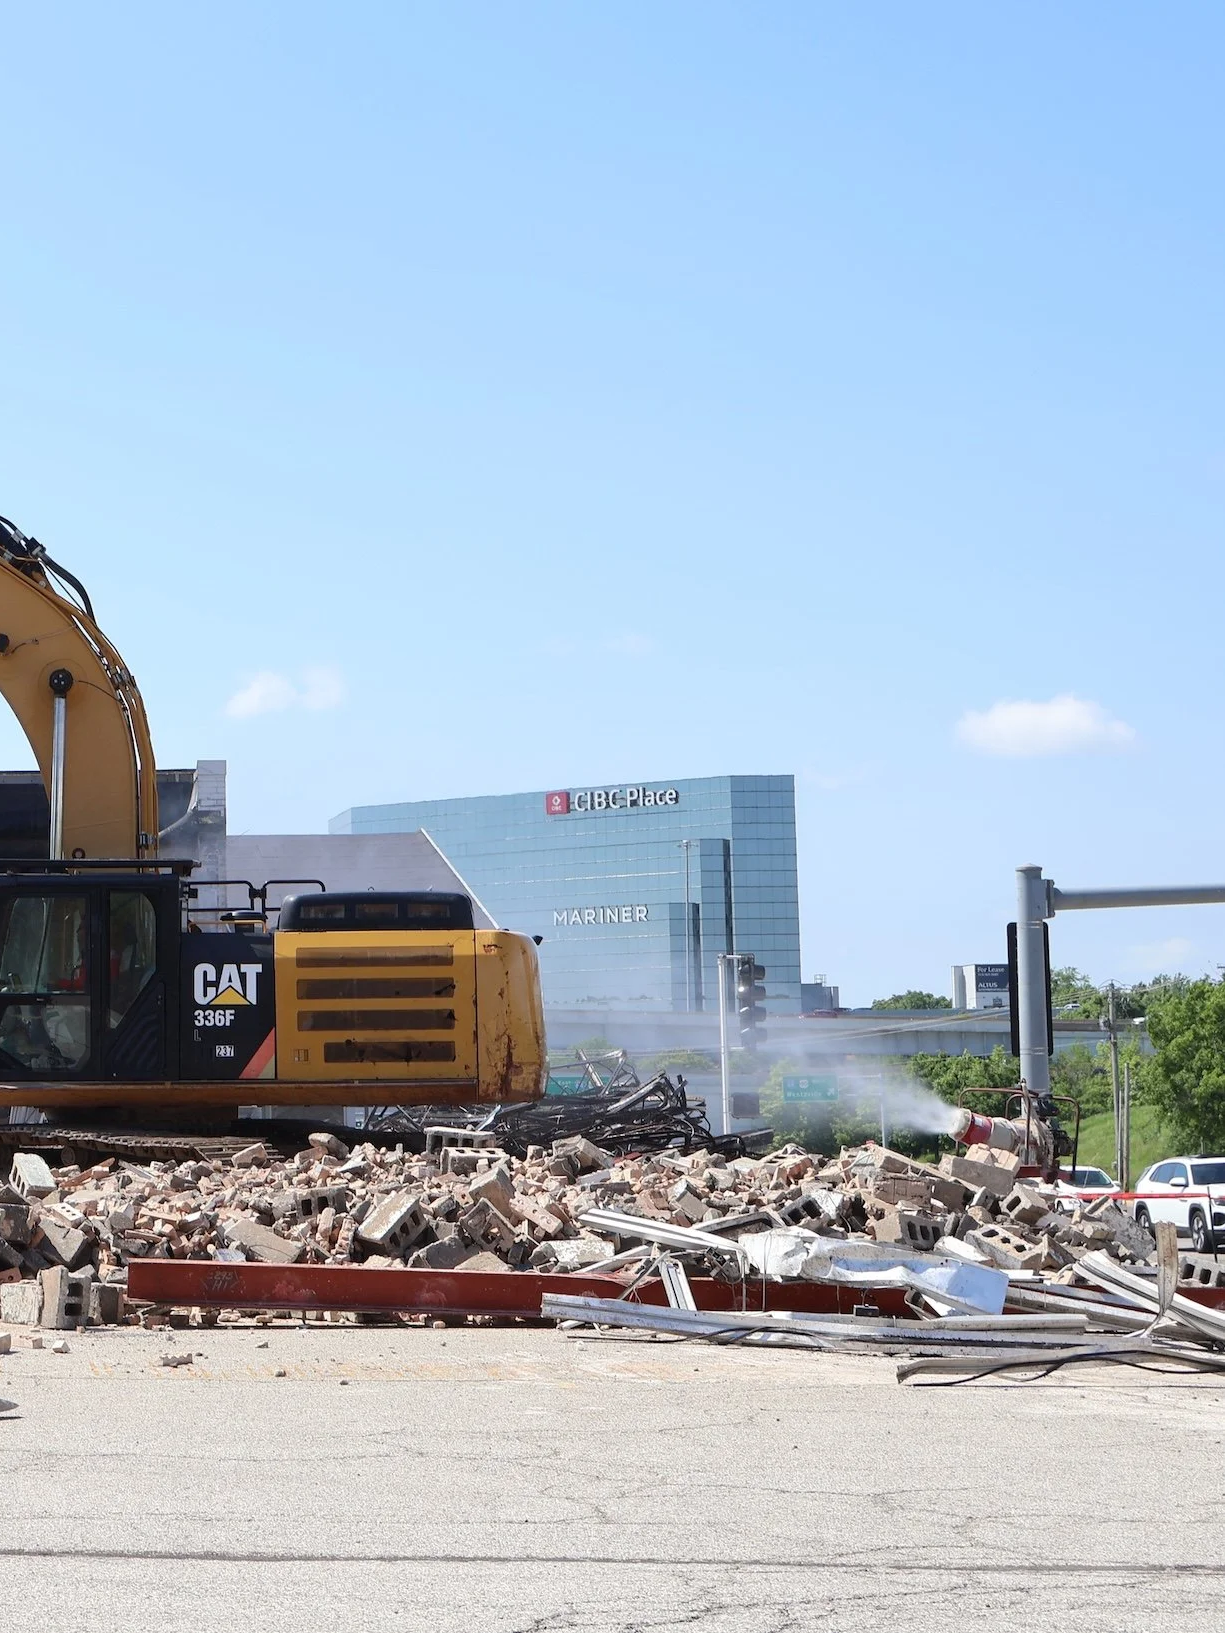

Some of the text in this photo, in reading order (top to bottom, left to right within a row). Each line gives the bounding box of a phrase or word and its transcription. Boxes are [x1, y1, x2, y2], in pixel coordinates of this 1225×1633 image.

[575, 786, 677, 812] CIBC Place
[553, 906, 649, 926] MARINER
[193, 962, 263, 1006] CAT
[194, 1009, 235, 1027] 336F
[193, 1029, 202, 1041] L
[216, 1045, 234, 1057] 237
